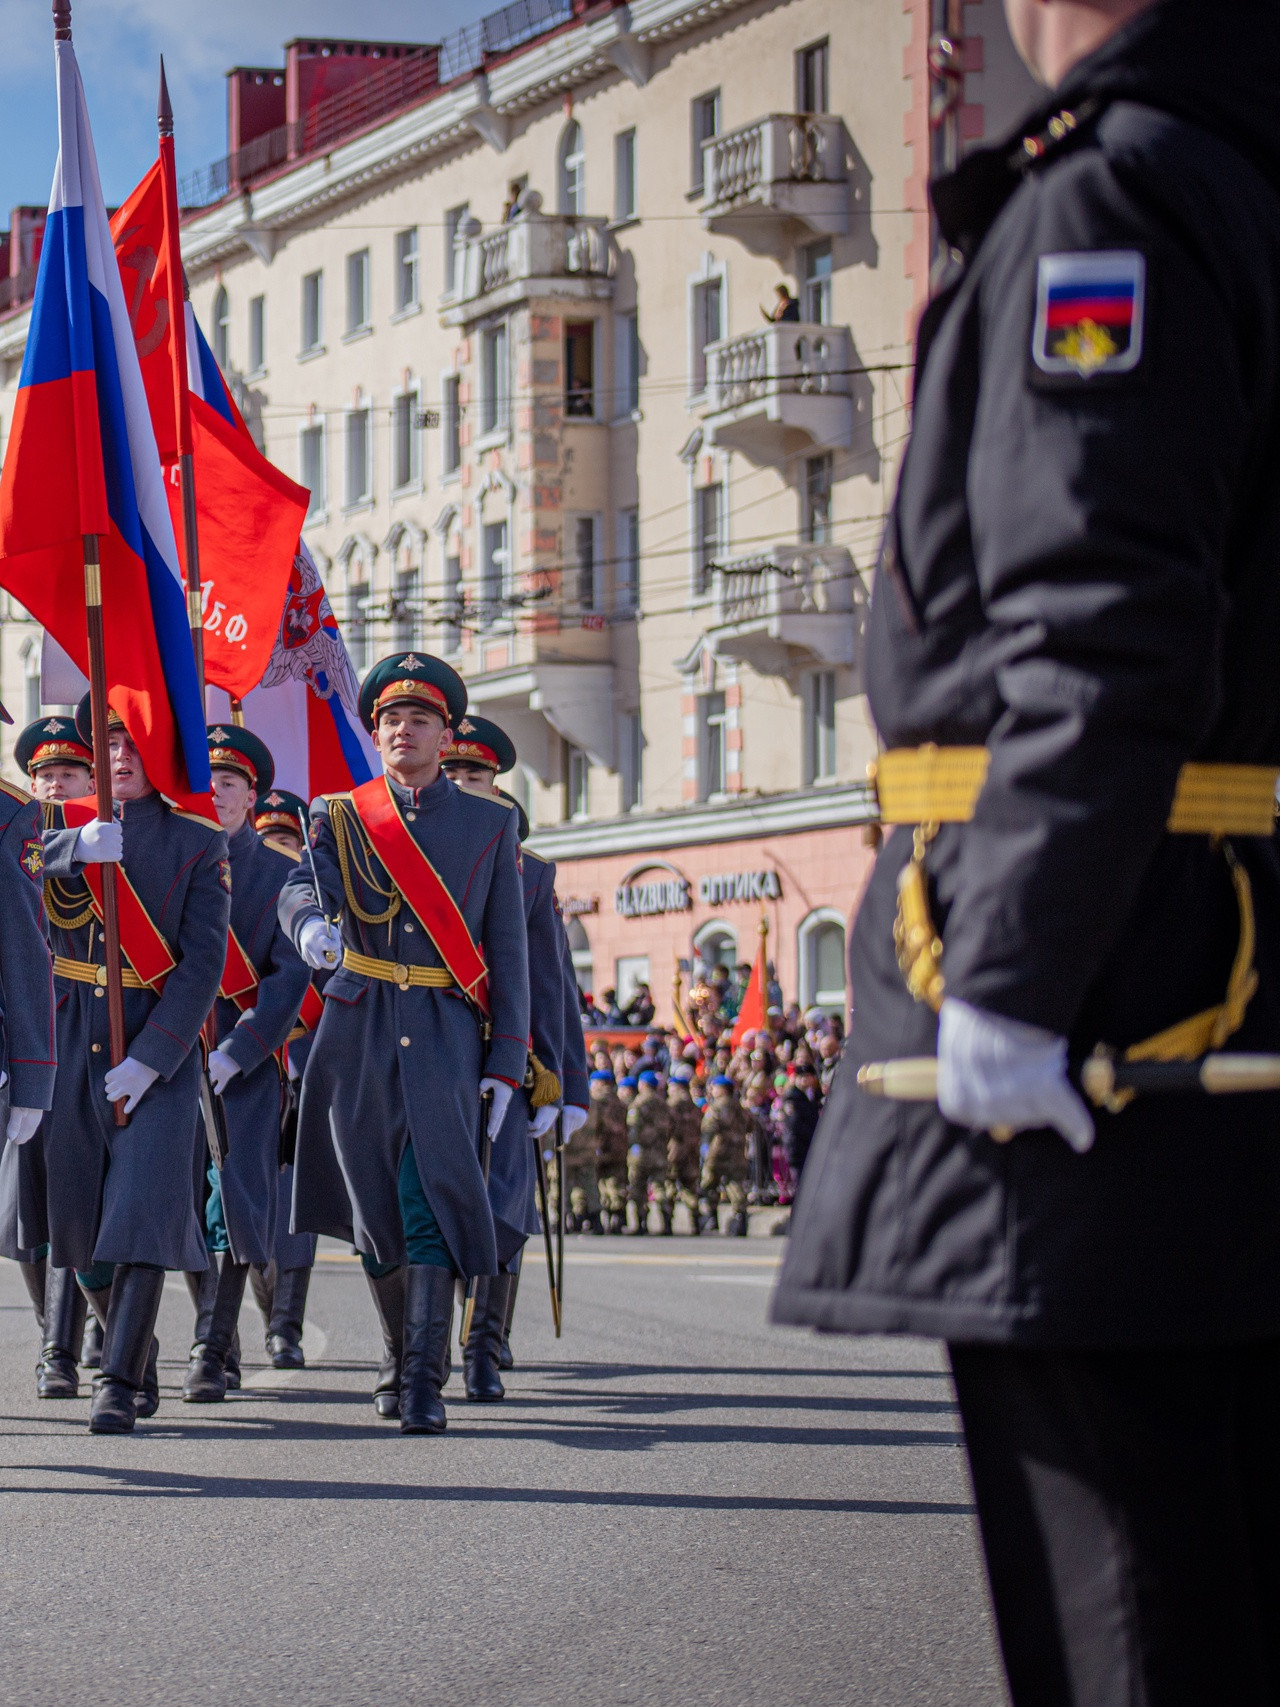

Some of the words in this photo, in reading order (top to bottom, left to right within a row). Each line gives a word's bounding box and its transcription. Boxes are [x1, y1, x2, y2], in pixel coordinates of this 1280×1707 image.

[27, 842, 44, 851] РОССИ
[615, 878, 692, 917] GLAZBURG
[699, 870, 782, 904] ОПТИКА
